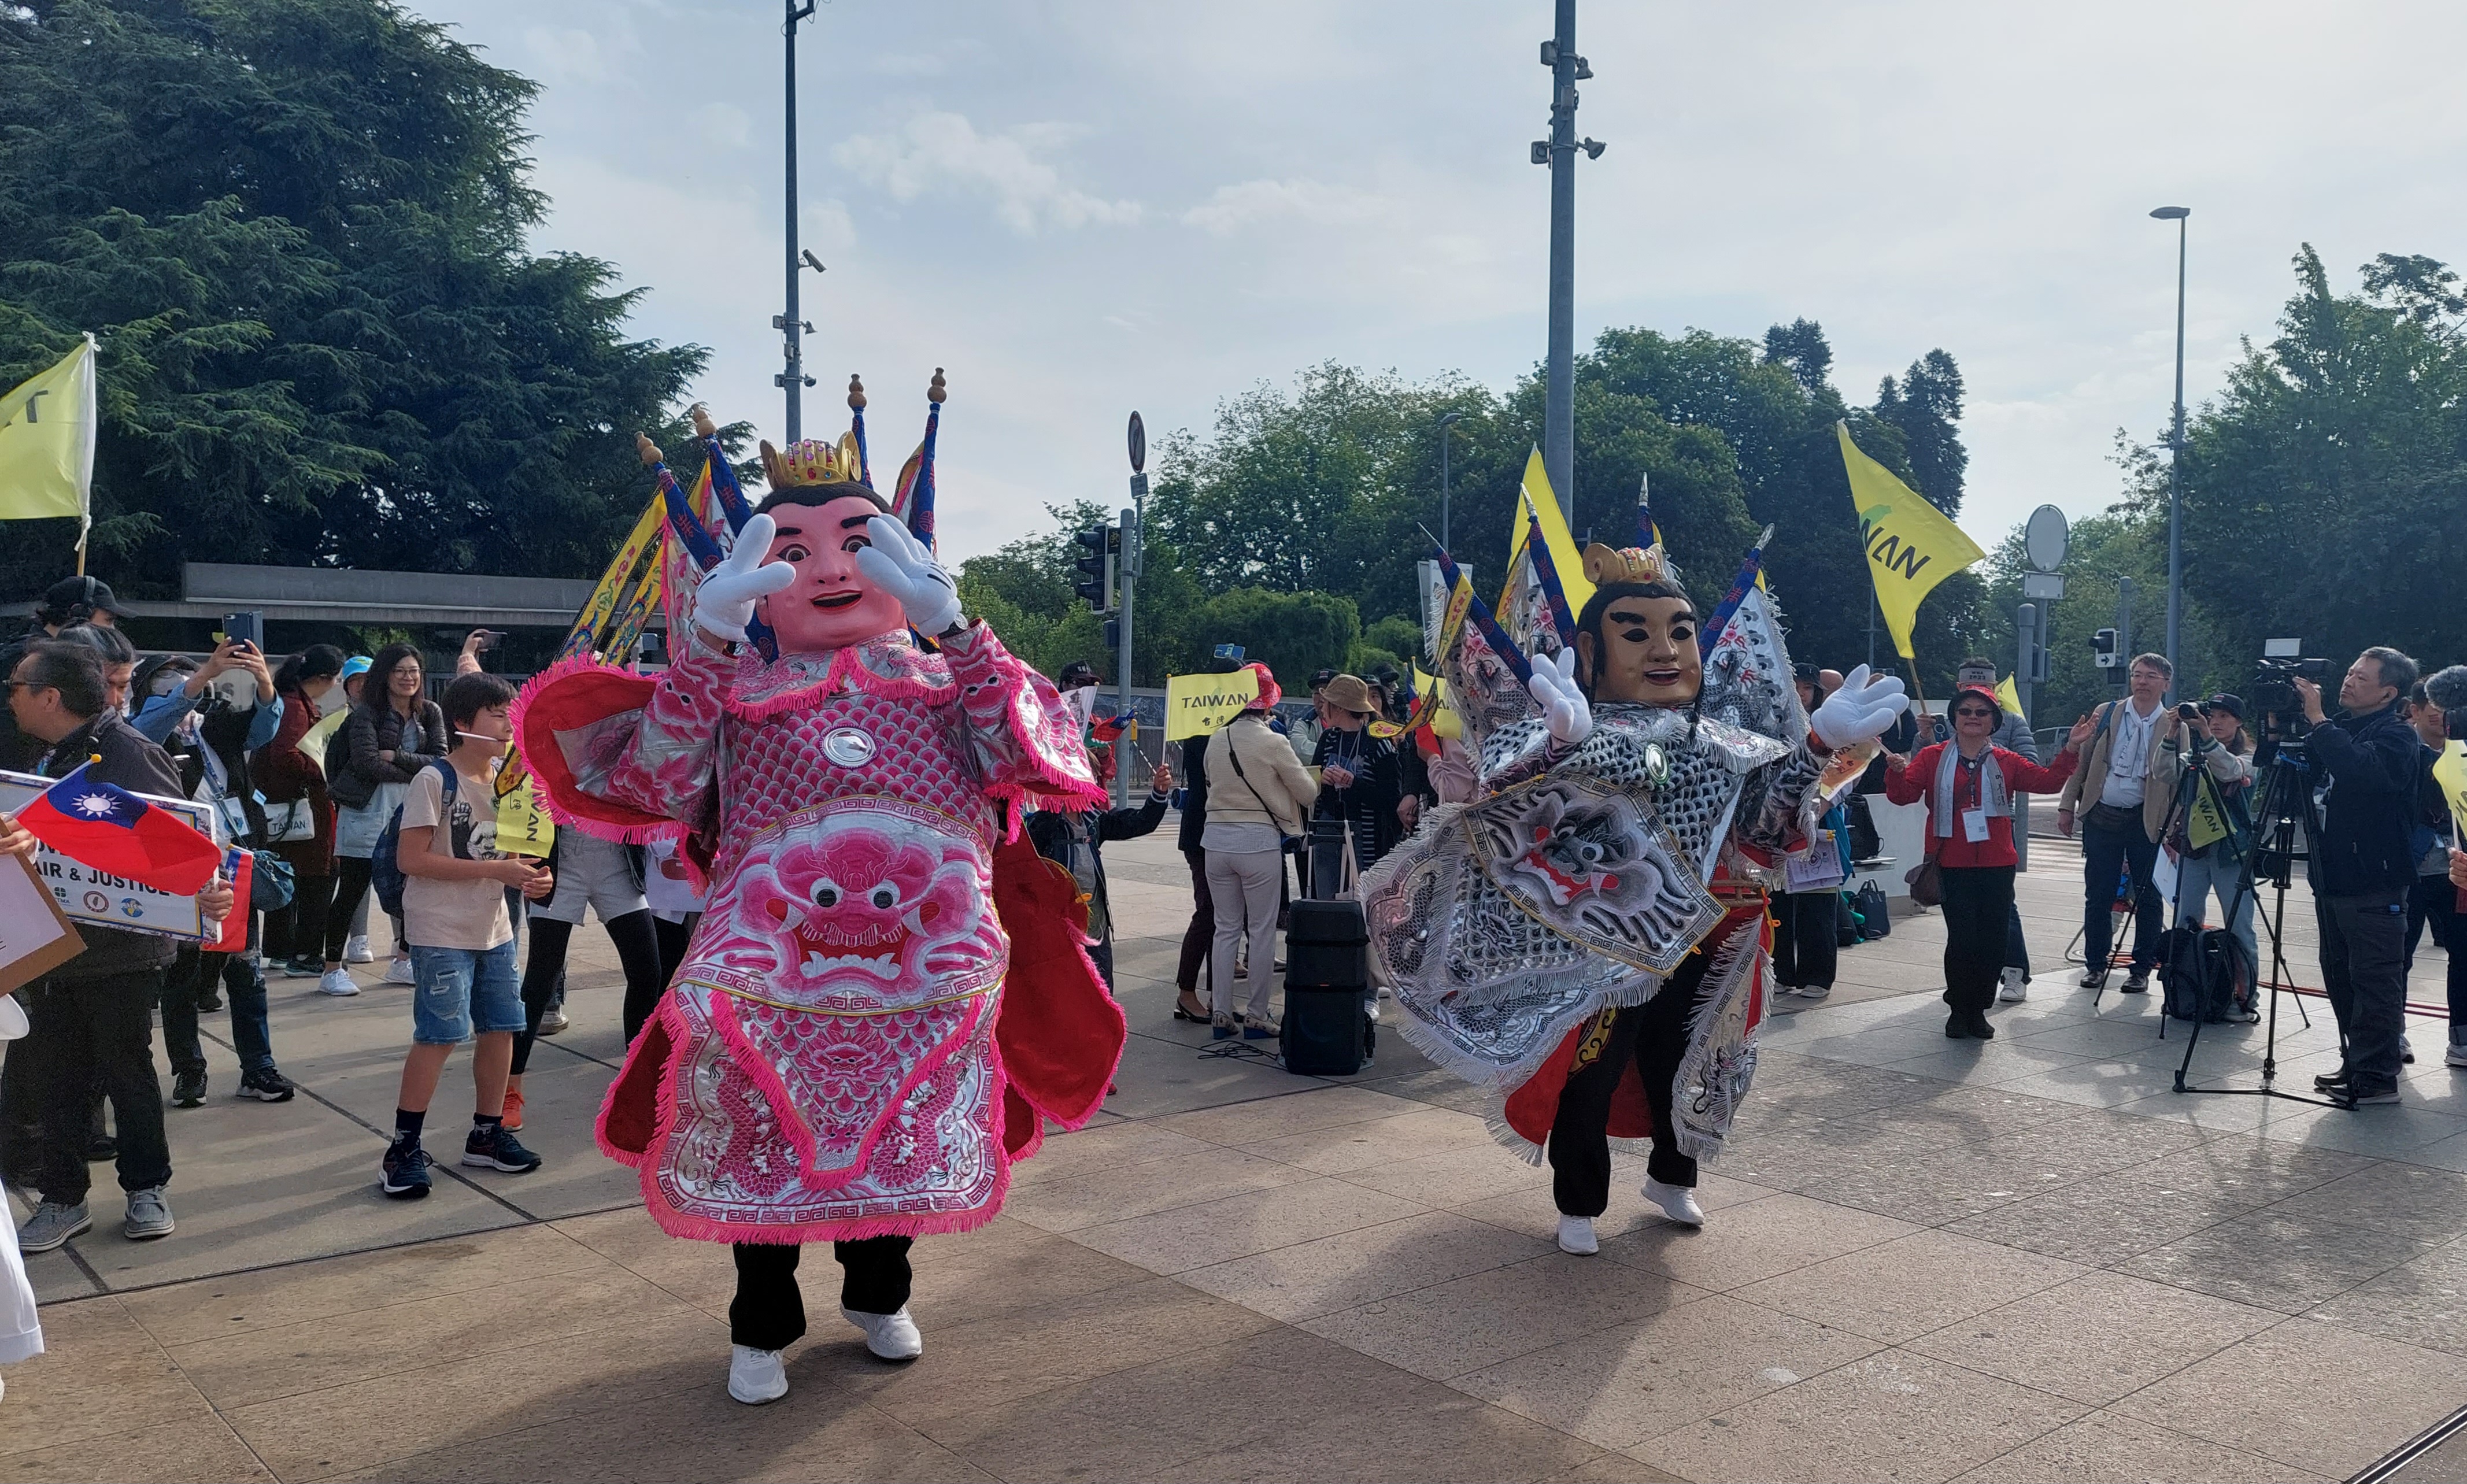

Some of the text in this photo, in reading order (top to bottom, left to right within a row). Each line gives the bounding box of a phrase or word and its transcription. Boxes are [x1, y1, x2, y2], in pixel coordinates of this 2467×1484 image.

[1861, 517, 1932, 580] WAN
[1181, 693, 1248, 708] TAIWAN
[2198, 795, 2220, 832] IWAN
[69, 867, 81, 881] &
